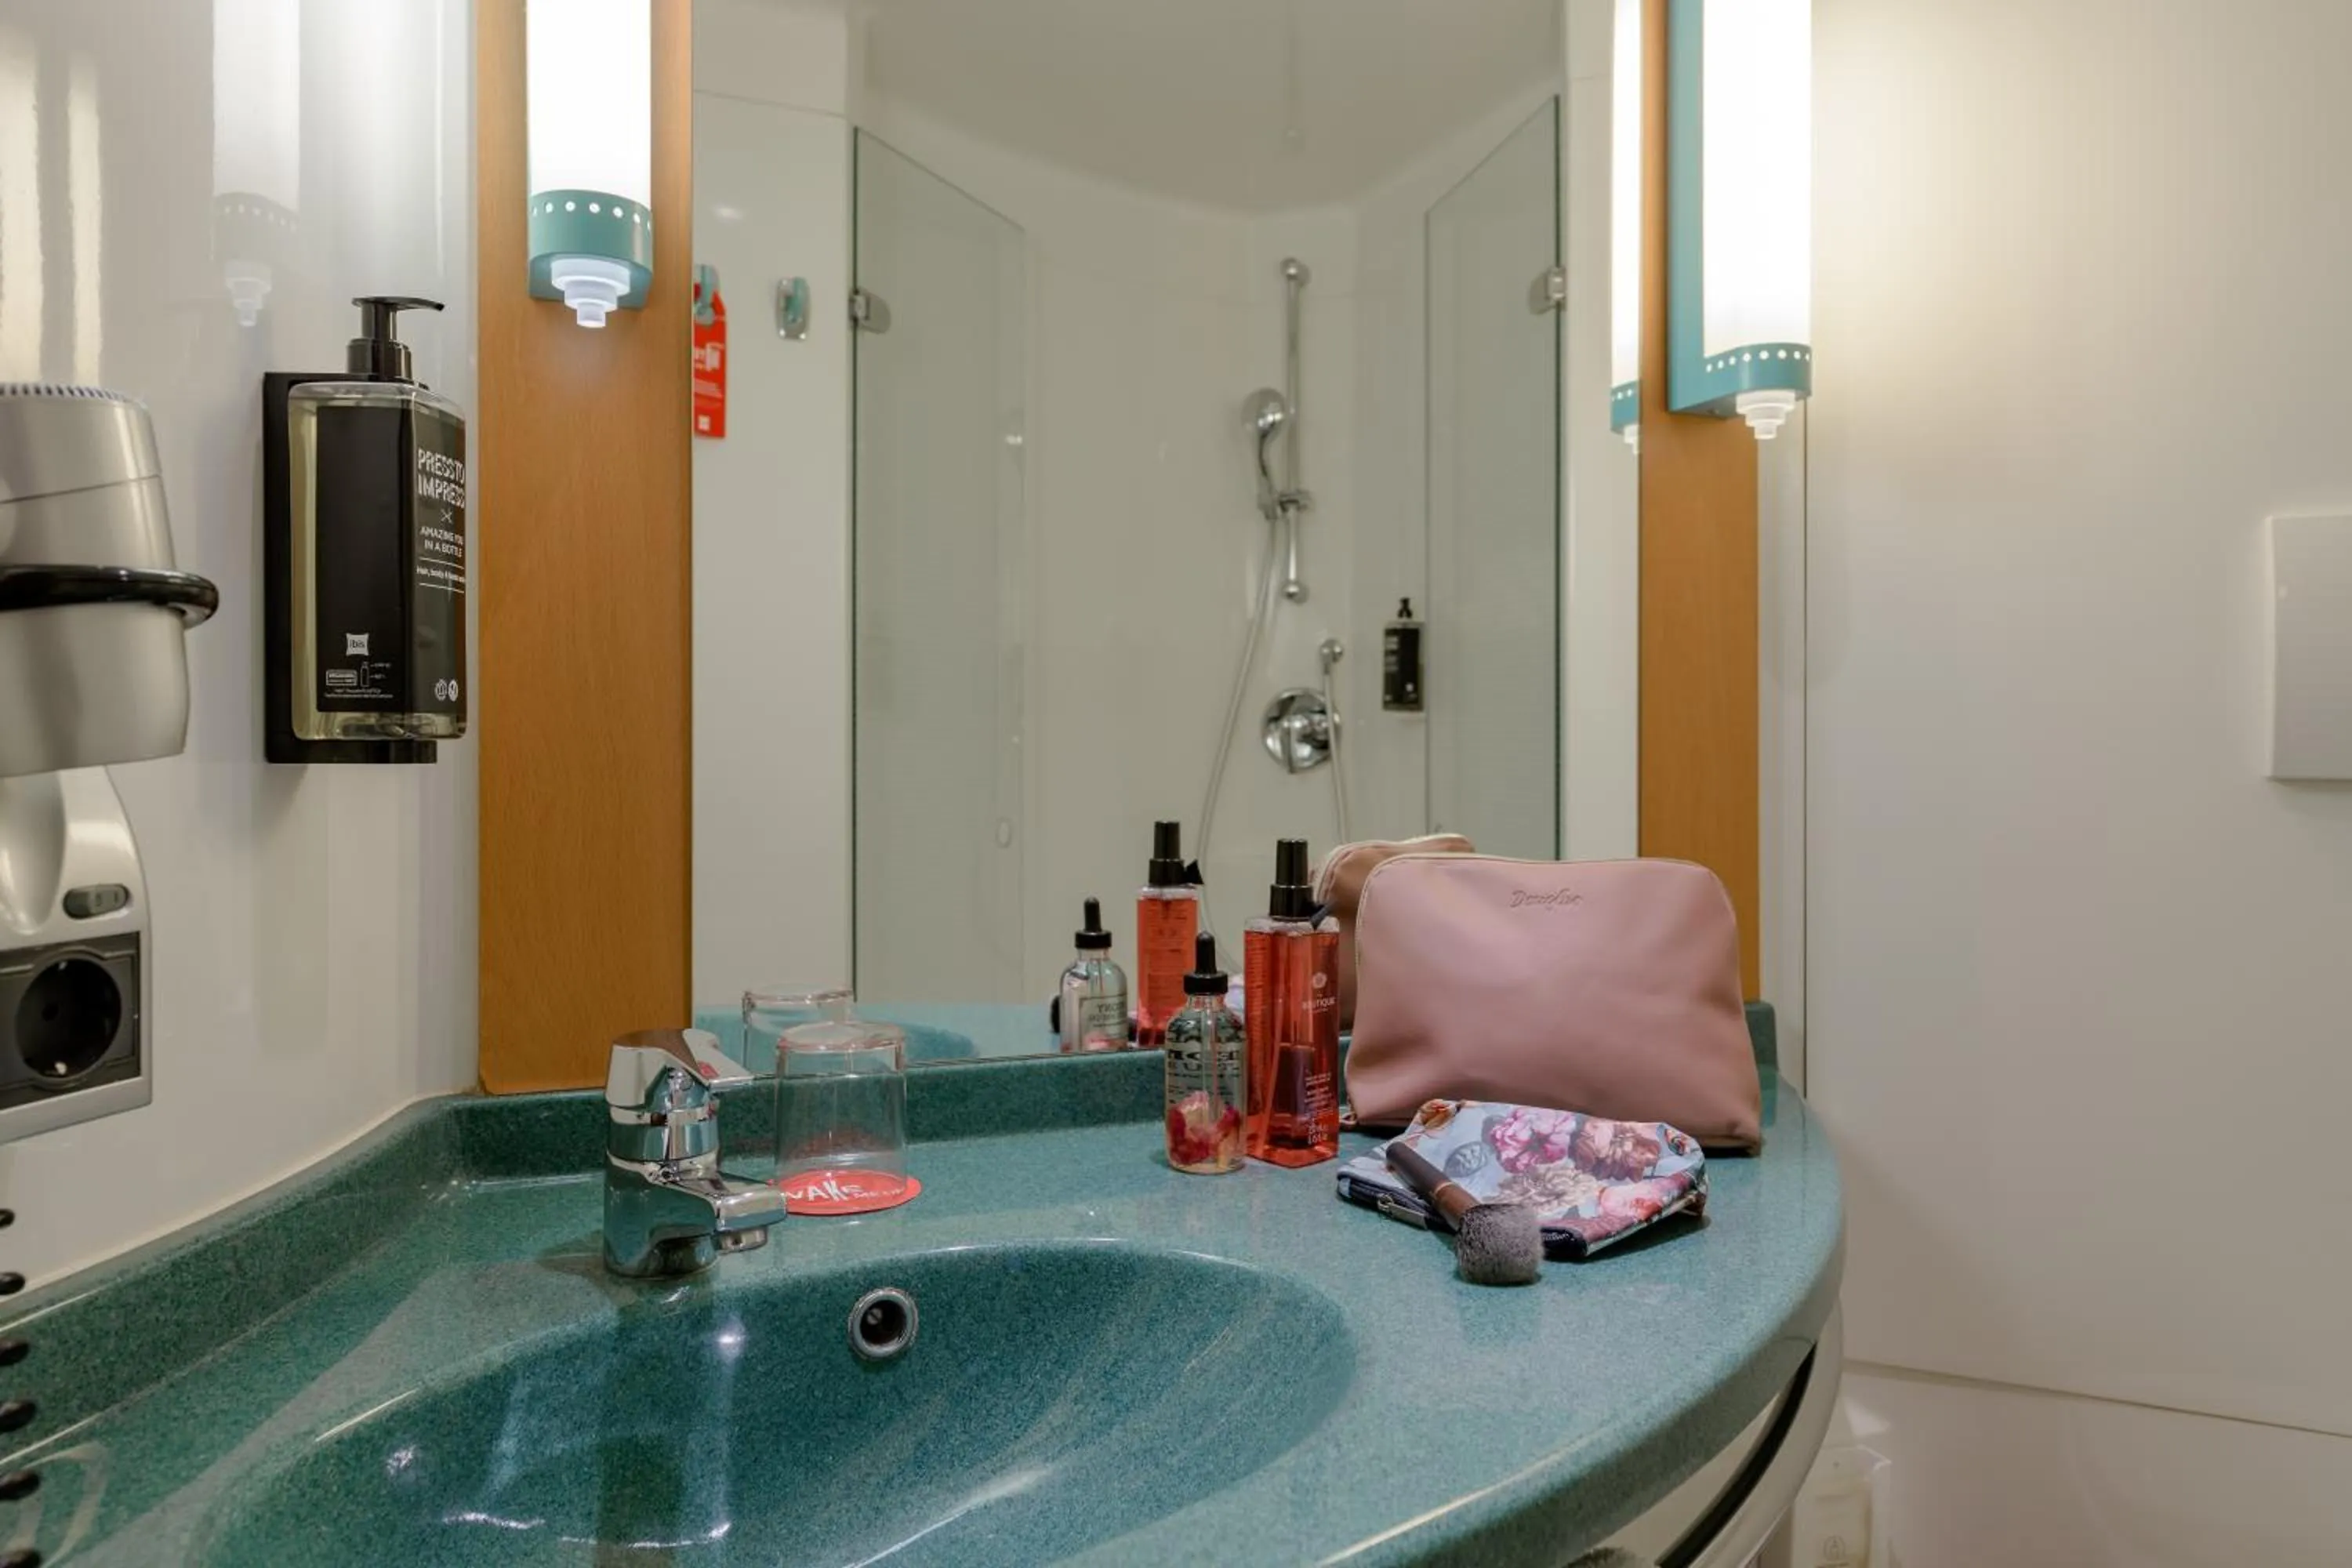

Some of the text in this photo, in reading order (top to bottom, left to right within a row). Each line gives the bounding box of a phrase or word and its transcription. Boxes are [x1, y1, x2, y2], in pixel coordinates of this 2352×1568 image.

[418, 447, 455, 481] PRESS
[418, 473, 465, 509] IMPRESS
[424, 539, 463, 557] IN A BOTTLE
